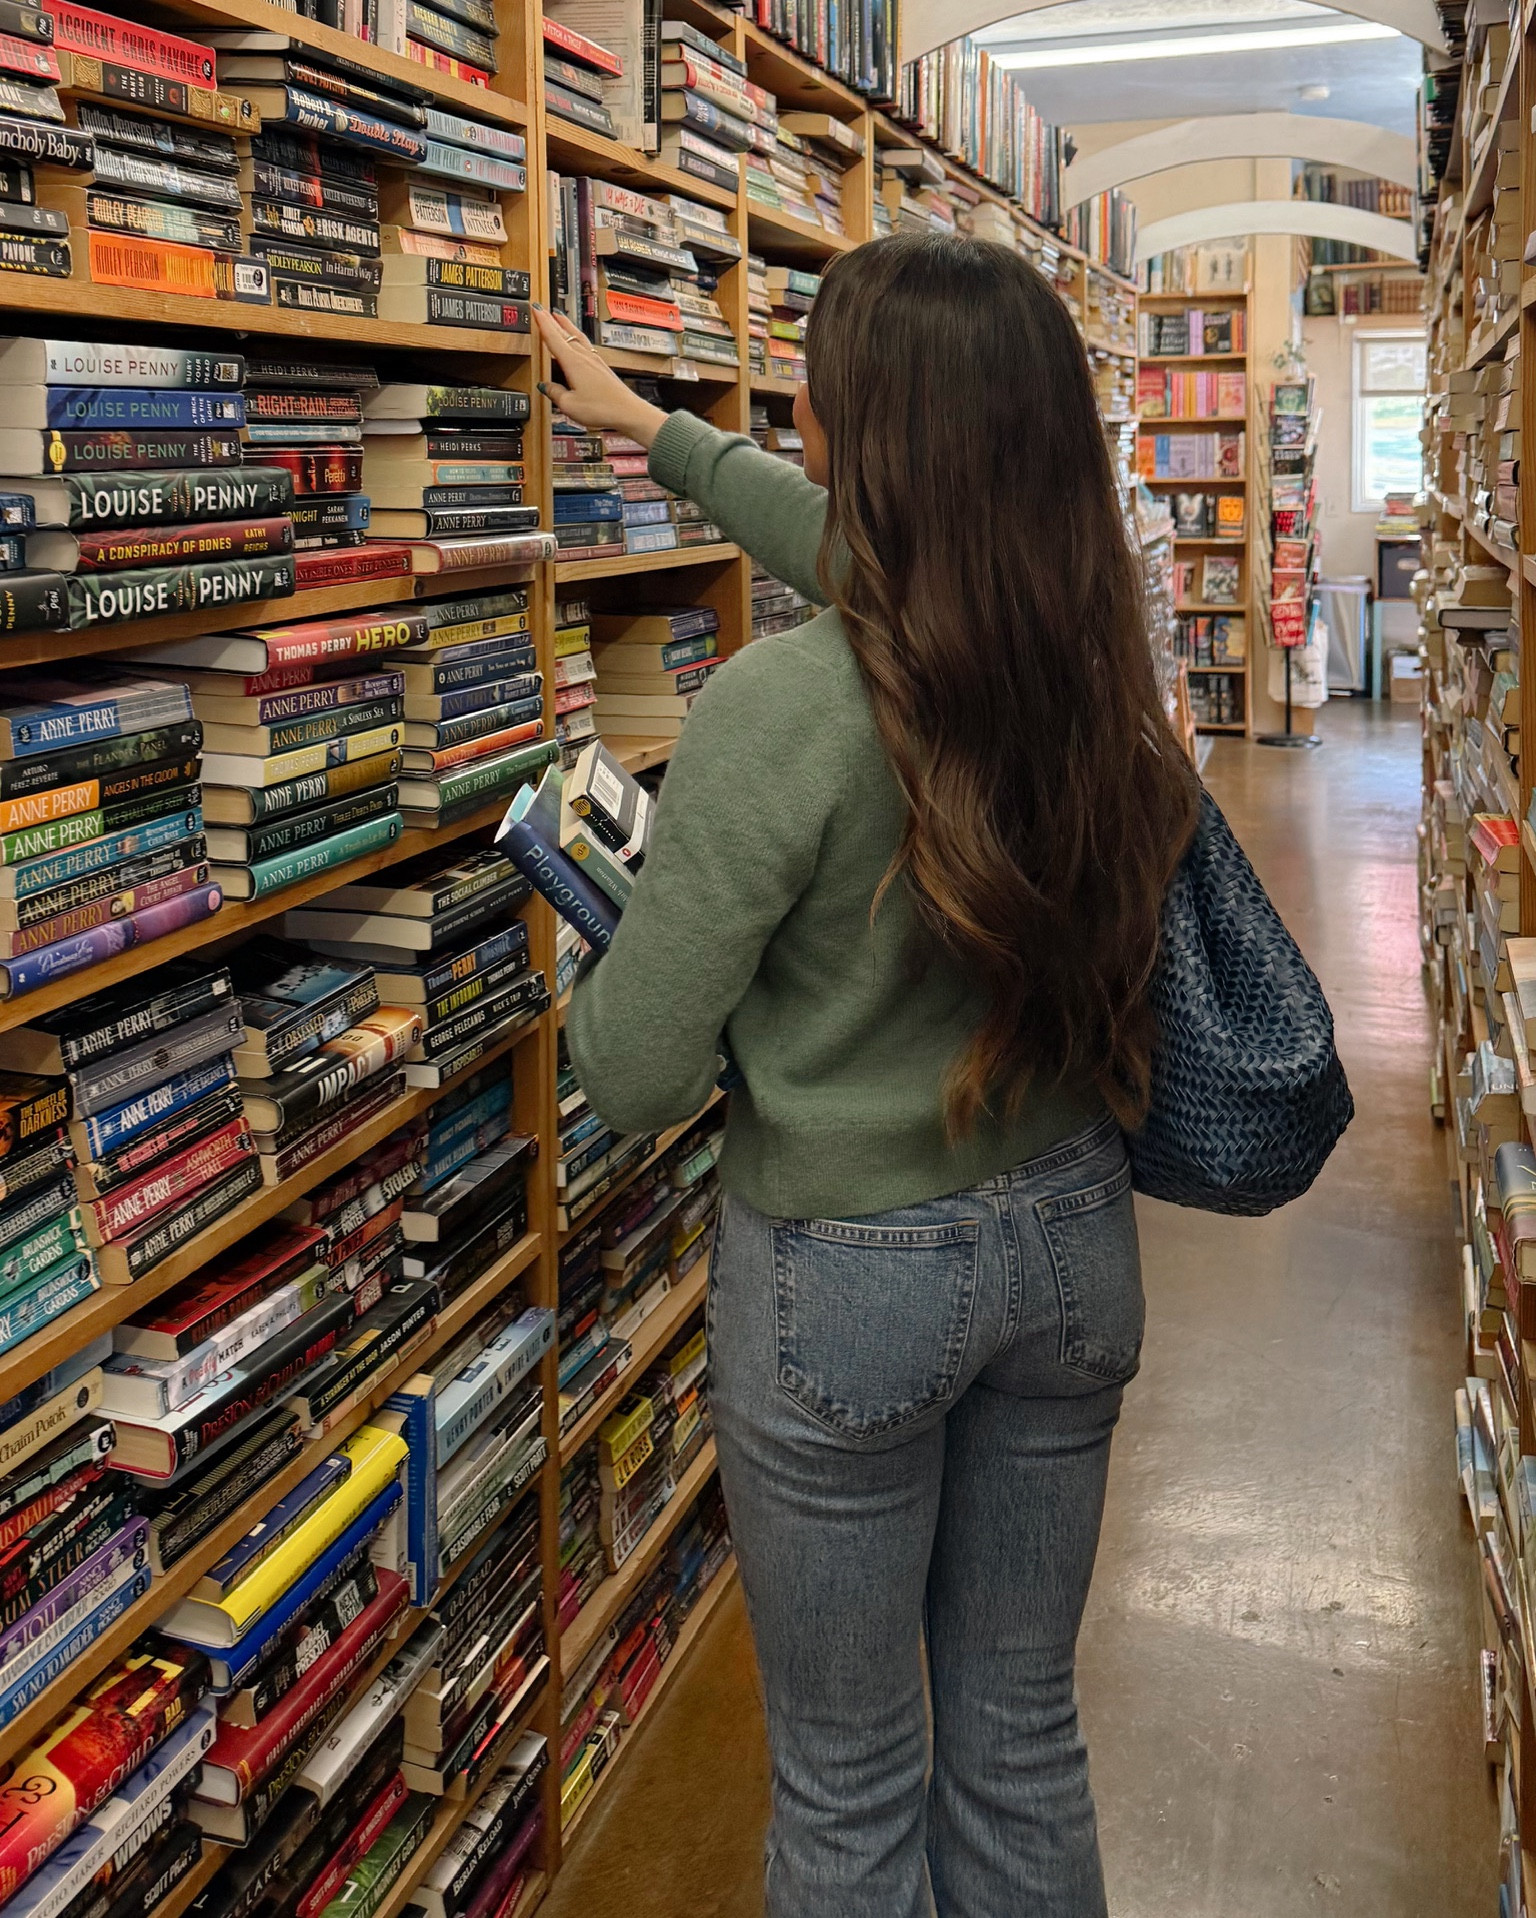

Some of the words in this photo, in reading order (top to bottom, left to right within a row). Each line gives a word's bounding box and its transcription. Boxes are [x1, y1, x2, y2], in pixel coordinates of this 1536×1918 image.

[58, 12, 116, 53] ACCIDENT
[121, 31, 156, 66] CHRIS
[160, 43, 201, 80] PAVONE
[297, 109, 328, 130] Parker
[348, 114, 390, 142] Double
[391, 128, 419, 156] Play
[47, 133, 80, 166] Baby
[415, 204, 447, 225] PATTERSON
[465, 215, 494, 235] WITNESS
[466, 201, 488, 219] SILENT
[322, 219, 344, 239] RISK
[345, 224, 372, 246] AGENT
[2, 242, 37, 263] PAVONE
[95, 244, 122, 275] RIDLEY
[124, 250, 159, 280] PEARSON
[359, 267, 372, 281] Way
[440, 263, 463, 285] JAMES
[465, 266, 503, 291] PATTERSON
[440, 298, 464, 319] JAMES
[465, 301, 501, 324] PATTERSON
[64, 356, 123, 375] LOUISE
[128, 361, 179, 376] PENNY
[262, 364, 288, 375] HEIDI
[291, 366, 319, 377] PERKS
[65, 402, 125, 418] LOUISE
[130, 403, 180, 418] PENNY
[257, 395, 295, 415] RIGHT
[300, 396, 327, 416] RAIN
[438, 396, 468, 408] LOUISE
[470, 397, 497, 409] PENNY
[74, 444, 132, 460] LOUISE
[138, 444, 187, 458] PENNY
[440, 442, 459, 451] HEIDI
[460, 442, 481, 451] PERKS
[324, 468, 345, 484] Peretti
[80, 489, 163, 519] LOUISE
[194, 484, 258, 512] PENNY
[327, 505, 344, 514] SARAH
[428, 492, 447, 503] ANNE
[448, 492, 467, 502] PERRY
[244, 528, 266, 538] KATHY
[322, 514, 349, 523] PEKKANEN
[436, 518, 460, 530] ANNE
[462, 515, 486, 529] PERRY
[96, 548, 105, 562] A
[109, 542, 178, 560] CONSPIRACY
[182, 540, 196, 554] OF
[198, 537, 232, 552] BONES
[447, 549, 475, 567] ANNE
[477, 546, 508, 564] PERRY
[85, 583, 168, 620] LOUISE
[200, 571, 264, 604] PENNY
[456, 603, 479, 620] PERRY
[276, 644, 318, 662] THOMAS
[321, 637, 352, 654] PERRY
[356, 623, 411, 652] HERO
[432, 628, 455, 645] ANNE
[455, 623, 481, 642] PERRY
[250, 673, 281, 694] ANNE
[446, 669, 463, 684] ANNE
[464, 664, 483, 680] PERRY
[263, 699, 297, 720] ANNE
[300, 689, 336, 712] PERRY
[39, 718, 75, 741] ANNE
[78, 706, 118, 732] PERRY
[272, 729, 303, 750] ANNE
[305, 717, 338, 741] PERRY
[443, 722, 469, 744] ANNE
[470, 712, 498, 734] PERRY
[103, 782, 130, 797] ANGELS
[131, 778, 139, 789] IN
[140, 774, 153, 788] THE
[154, 767, 178, 783] GLOOM
[264, 786, 293, 813] ANNE
[297, 774, 327, 802] PERRY
[444, 779, 473, 802] ANNE
[474, 769, 500, 795] PERRY
[8, 793, 50, 827] ANNE
[52, 784, 92, 815] PERRY
[14, 828, 58, 860] ANNE
[60, 814, 102, 846] PERRY
[258, 826, 291, 853] ANNE
[294, 816, 326, 842] PERRY
[20, 862, 63, 892] ANNE
[65, 845, 110, 874] PERRY
[260, 864, 293, 890] ANNE
[296, 850, 330, 876] PERRY
[24, 892, 68, 922] ANNE
[72, 875, 118, 905] PERRY
[438, 893, 450, 909] THE
[450, 882, 473, 901] SOCIAL
[473, 872, 498, 891] CLIMBER
[20, 920, 59, 950] ANNE
[62, 903, 104, 934] PERRY
[452, 952, 477, 981] PERRY
[436, 999, 450, 1018] THE
[450, 977, 484, 1008] INFORMANT
[82, 1027, 114, 1055] ANNE
[117, 1010, 152, 1037] PERRY
[430, 1028, 454, 1048] GEORGE
[454, 1010, 486, 1038] PELECANOS
[318, 1051, 373, 1107] IMPACT
[20, 1106, 33, 1119] THE
[34, 1092, 57, 1113] WHEEL
[57, 1088, 66, 1098] OF
[20, 1100, 68, 1139] DARKNESS
[121, 1103, 148, 1132] ANNE
[149, 1084, 174, 1115] PERRY
[185, 1133, 233, 1172] ASHWORTH
[292, 1139, 316, 1168] ANNE
[317, 1120, 344, 1147] PERRY
[200, 1159, 224, 1180] HALL
[383, 1162, 417, 1199] STOLEN
[114, 1197, 143, 1228] ANNE
[143, 1175, 171, 1207] PERRY
[143, 1230, 169, 1261] ANNE
[169, 1209, 195, 1241] PERRY
[341, 1210, 367, 1235] PINTER
[28, 1245, 64, 1272] GARDENS
[43, 1287, 80, 1316] GARDENS
[380, 1329, 402, 1352] JASON
[402, 1306, 426, 1334] PINTER
[217, 1336, 244, 1363] MATCH
[0, 1427, 34, 1464] Chaim
[35, 1406, 66, 1437] Potok
[202, 1399, 251, 1446] PRESTON
[514, 1462, 532, 1489] SCOTT
[531, 1444, 547, 1473] PRATT
[449, 1512, 486, 1563] REASONABLE
[485, 1497, 501, 1522] FEAR
[295, 1629, 331, 1678] PRESCOTT
[27, 1797, 89, 1872] PRESTON
[106, 1737, 154, 1792] CHILD
[70, 1850, 104, 1889] MAKER
[114, 1790, 158, 1841] RICHARD
[160, 1751, 196, 1795] POWERS
[112, 1798, 172, 1873] WIDOWS
[477, 1820, 503, 1860] RELOAD
[144, 1873, 169, 1909] SCOTT
